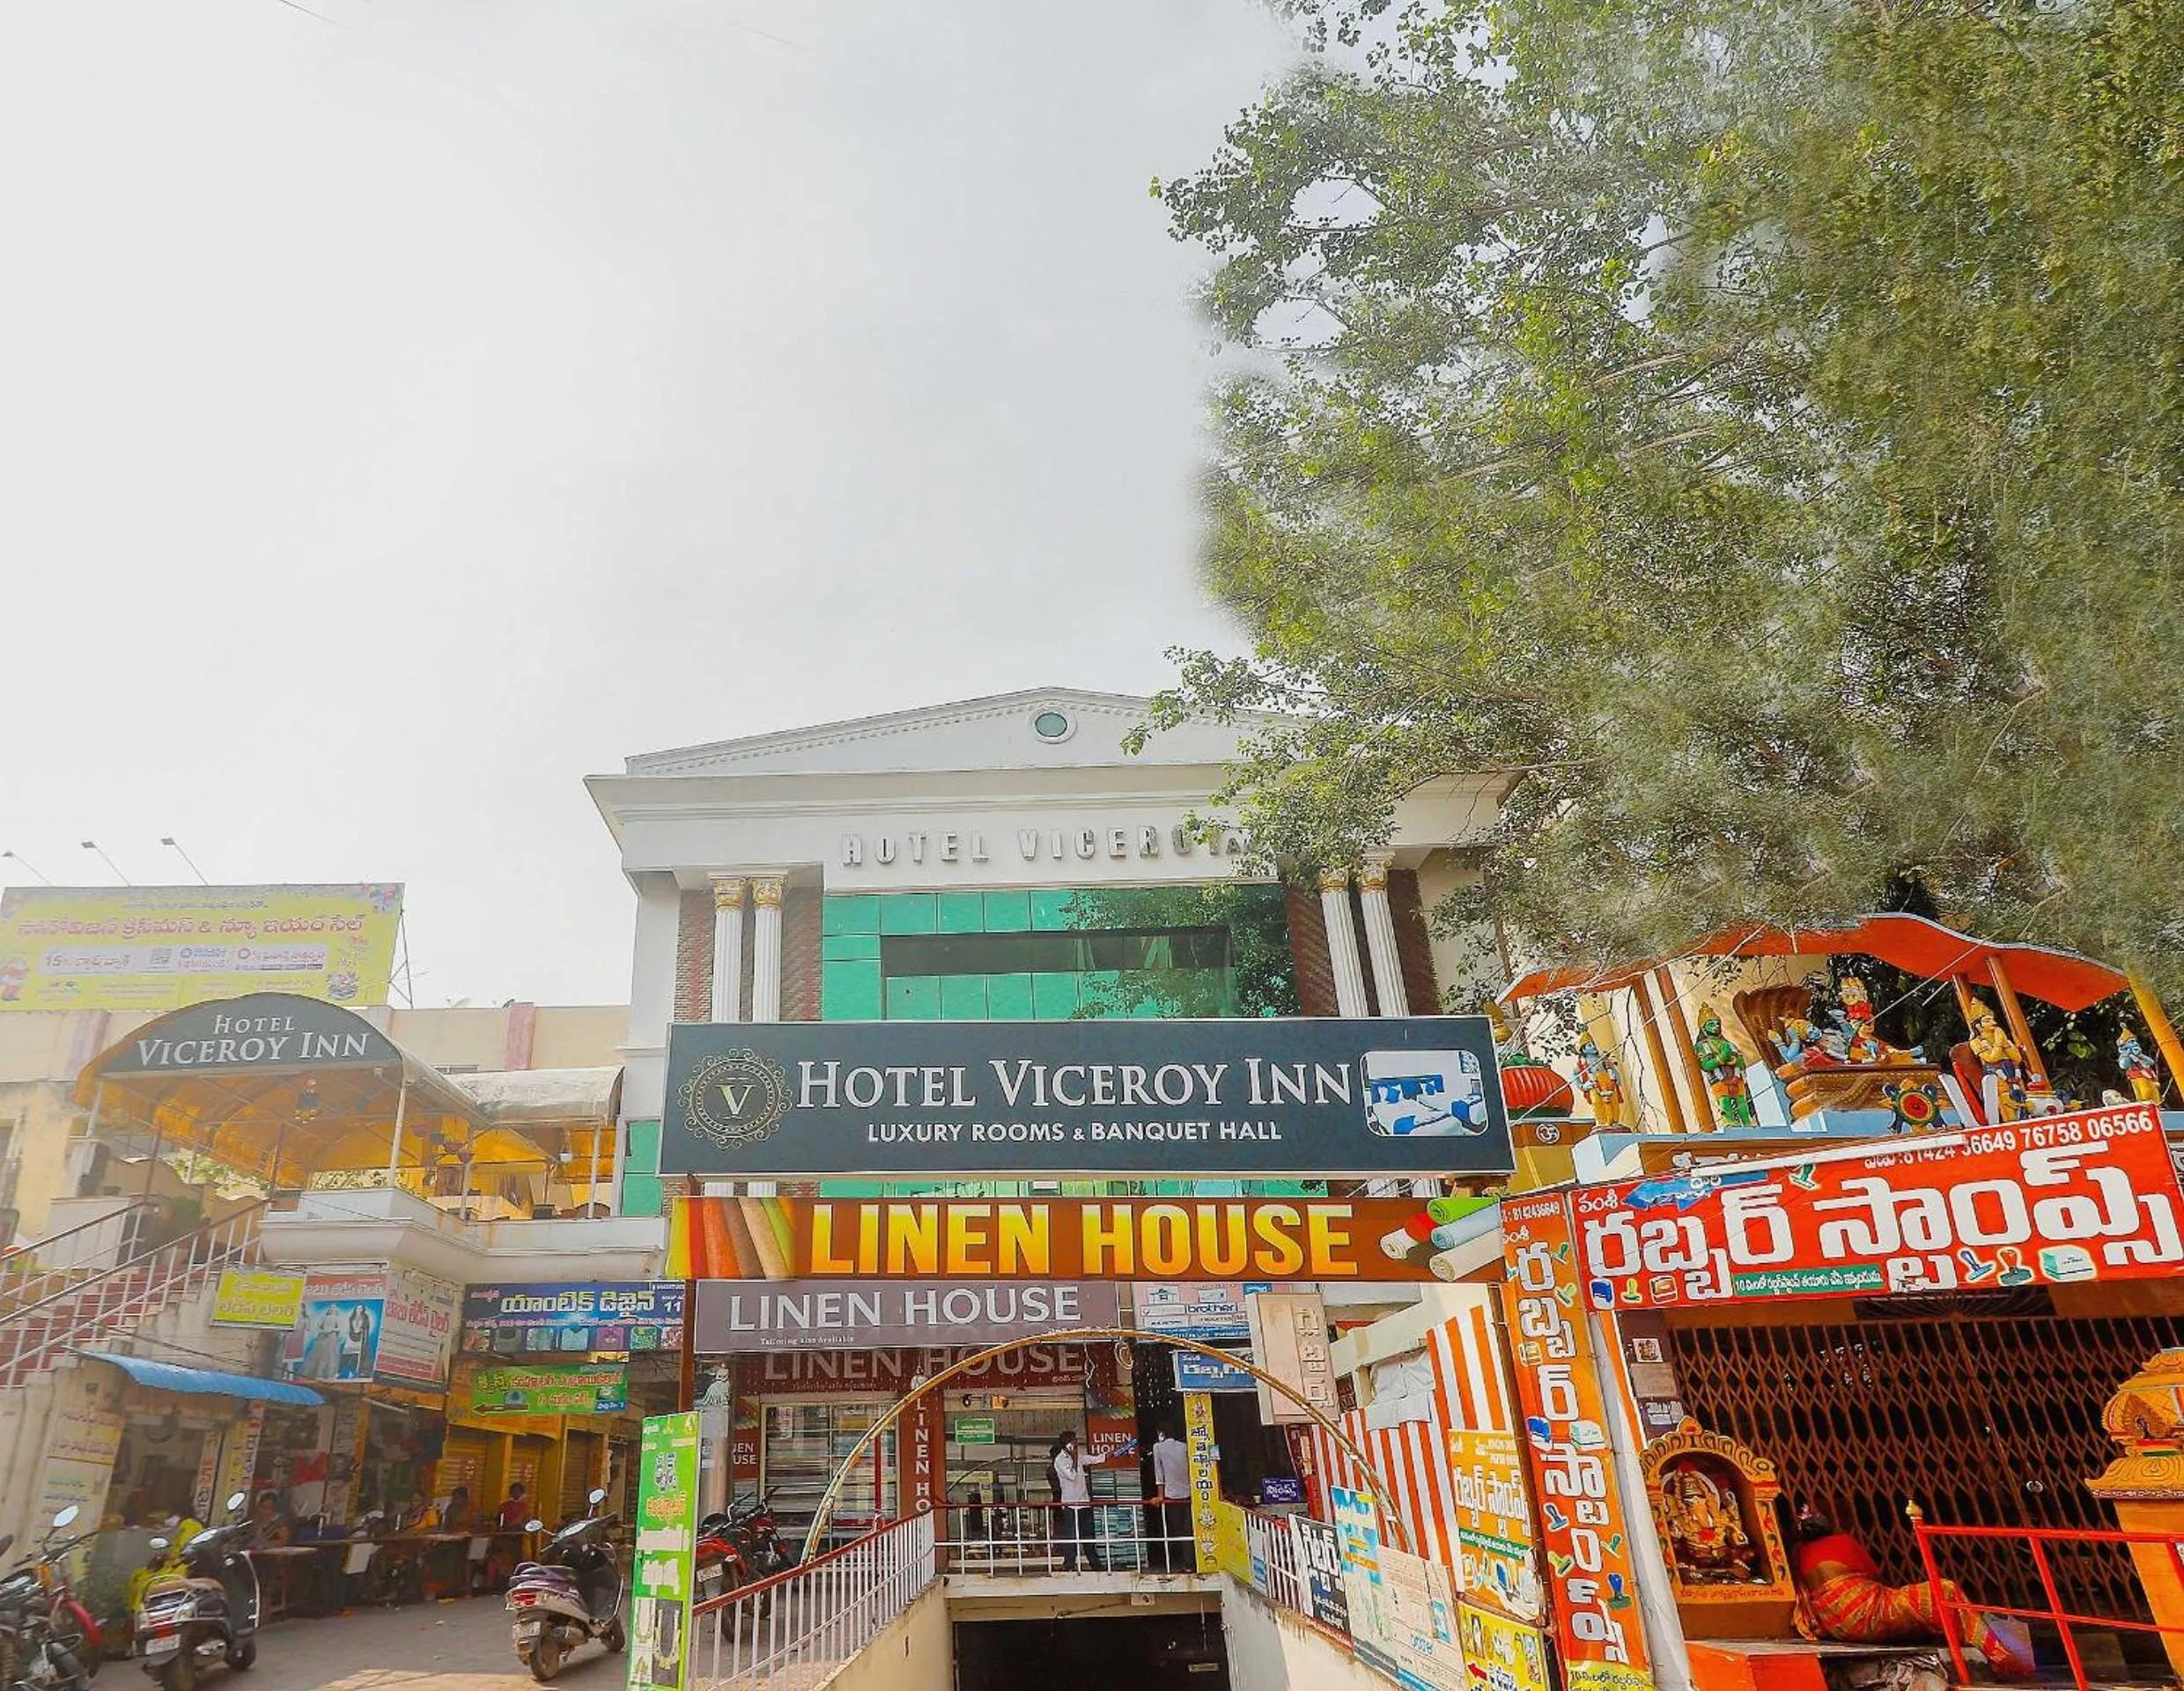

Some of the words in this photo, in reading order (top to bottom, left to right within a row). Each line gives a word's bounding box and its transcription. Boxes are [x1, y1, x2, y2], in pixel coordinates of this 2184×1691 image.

[842, 831, 990, 865] HOTEL
[214, 1014, 295, 1035] HOTEL
[136, 1037, 291, 1066] VICEROY
[300, 1031, 370, 1058] INN
[796, 1060, 978, 1109] HOTEL
[988, 1059, 1228, 1108] VICEROY
[1244, 1057, 1352, 1107] INN
[867, 1122, 964, 1144] LUXURY
[971, 1122, 1065, 1143] ROOMS
[1073, 1127, 1086, 1141] &
[1090, 1121, 1211, 1142] BANQUET
[1220, 1121, 1282, 1141] HALL
[2021, 1121, 2081, 1148] 76758
[2086, 1110, 2153, 1141] 06566
[810, 1203, 1051, 1274] LINEN
[1081, 1203, 1359, 1275] HOUSE
[729, 1291, 882, 1331] LINEN
[904, 1285, 1081, 1325] HOUSE
[1188, 1303, 1235, 1313] brother
[764, 1351, 902, 1380] LINEN
[924, 1343, 1083, 1377] HOUSE
[915, 1397, 930, 1475] LINEN
[1091, 1444, 1135, 1455] HOE
[1093, 1432, 1132, 1443] LINEN
[734, 1454, 757, 1465] USE
